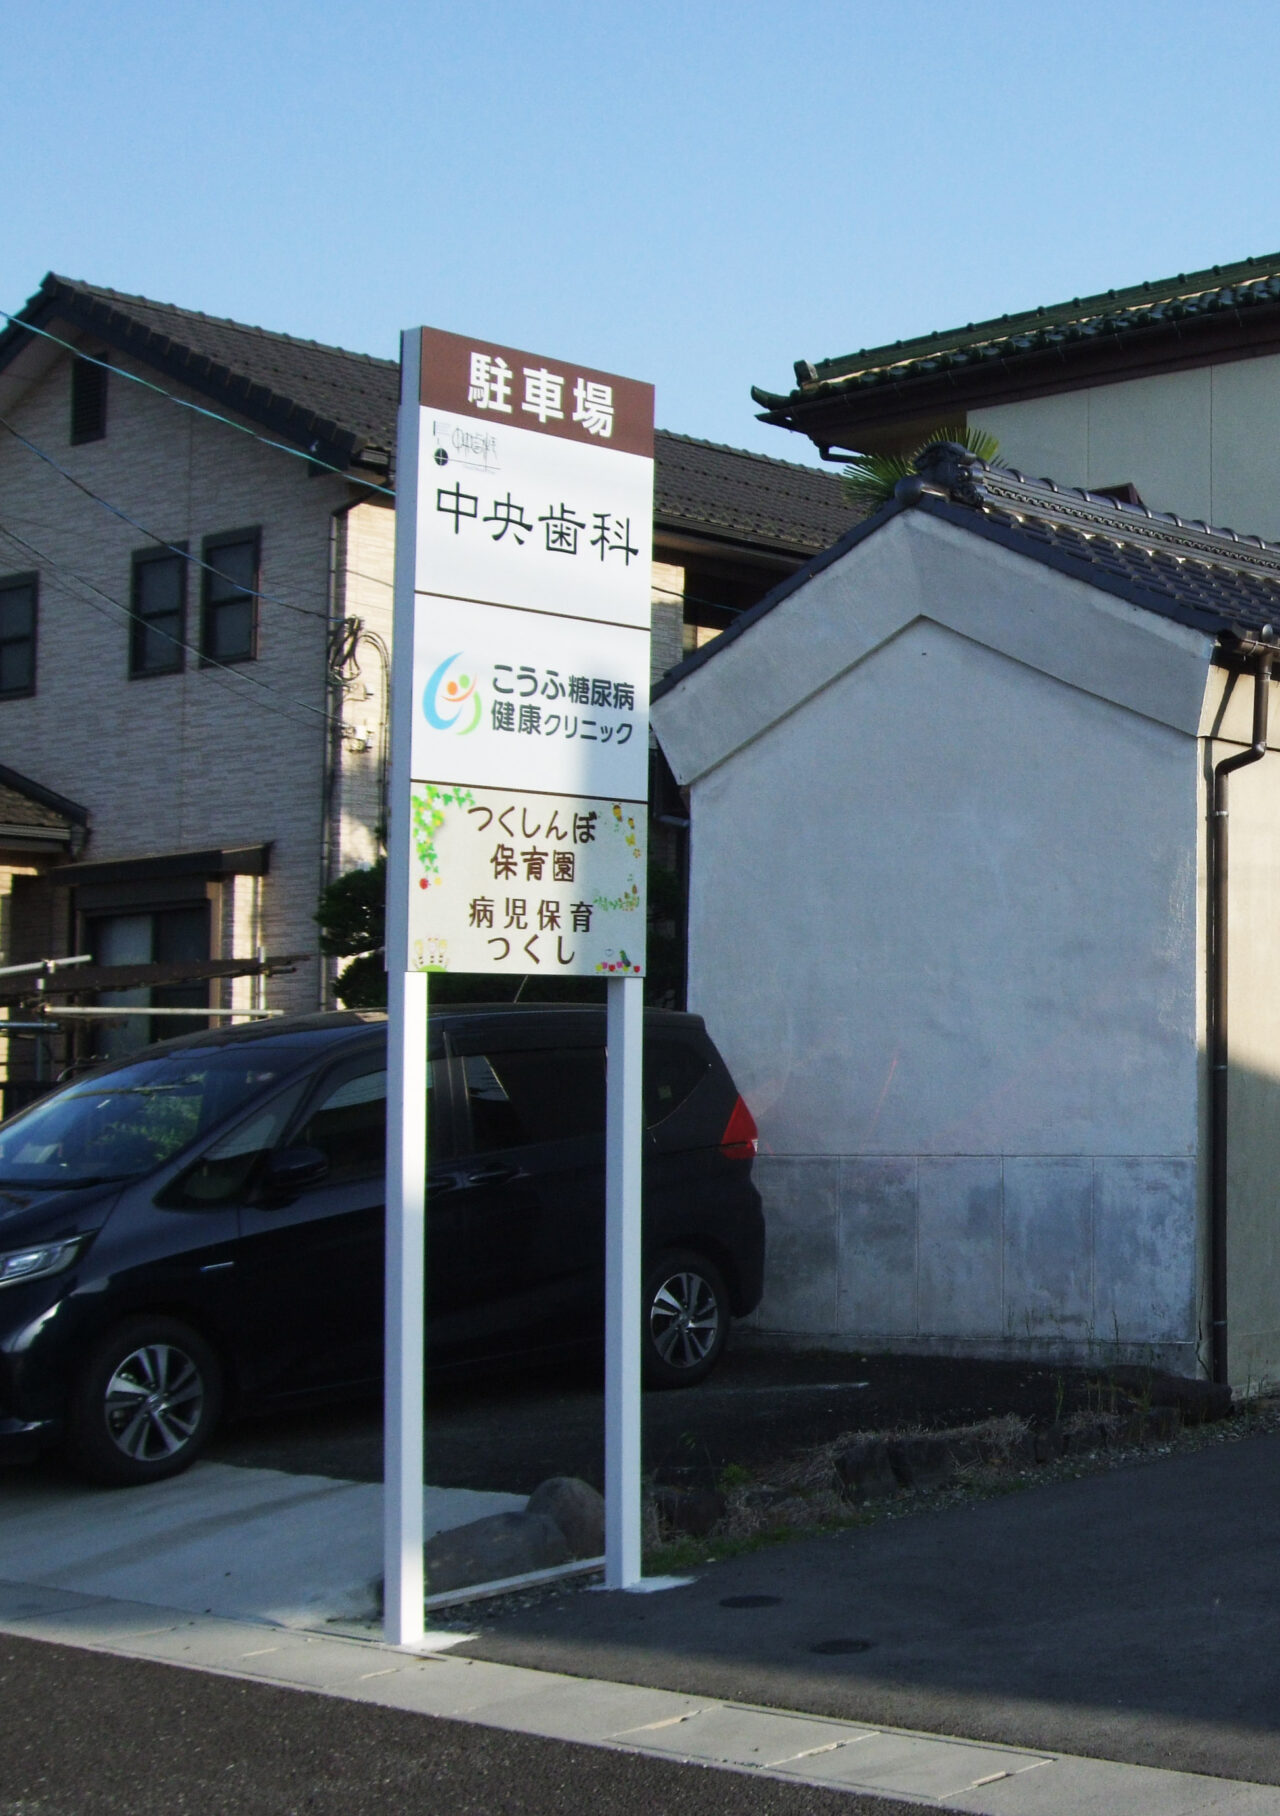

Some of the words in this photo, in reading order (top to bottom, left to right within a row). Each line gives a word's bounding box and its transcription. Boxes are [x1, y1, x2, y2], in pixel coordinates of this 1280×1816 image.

[467, 351, 614, 438] 駐車場
[436, 481, 639, 566] 中央歯科
[492, 664, 635, 711] こうふ糖尿病
[491, 699, 633, 744] 健康クリニック
[467, 806, 598, 844] つくしんぼ
[490, 843, 575, 882] 保育園
[469, 896, 593, 933] 病児保育
[487, 934, 575, 965] つくし
